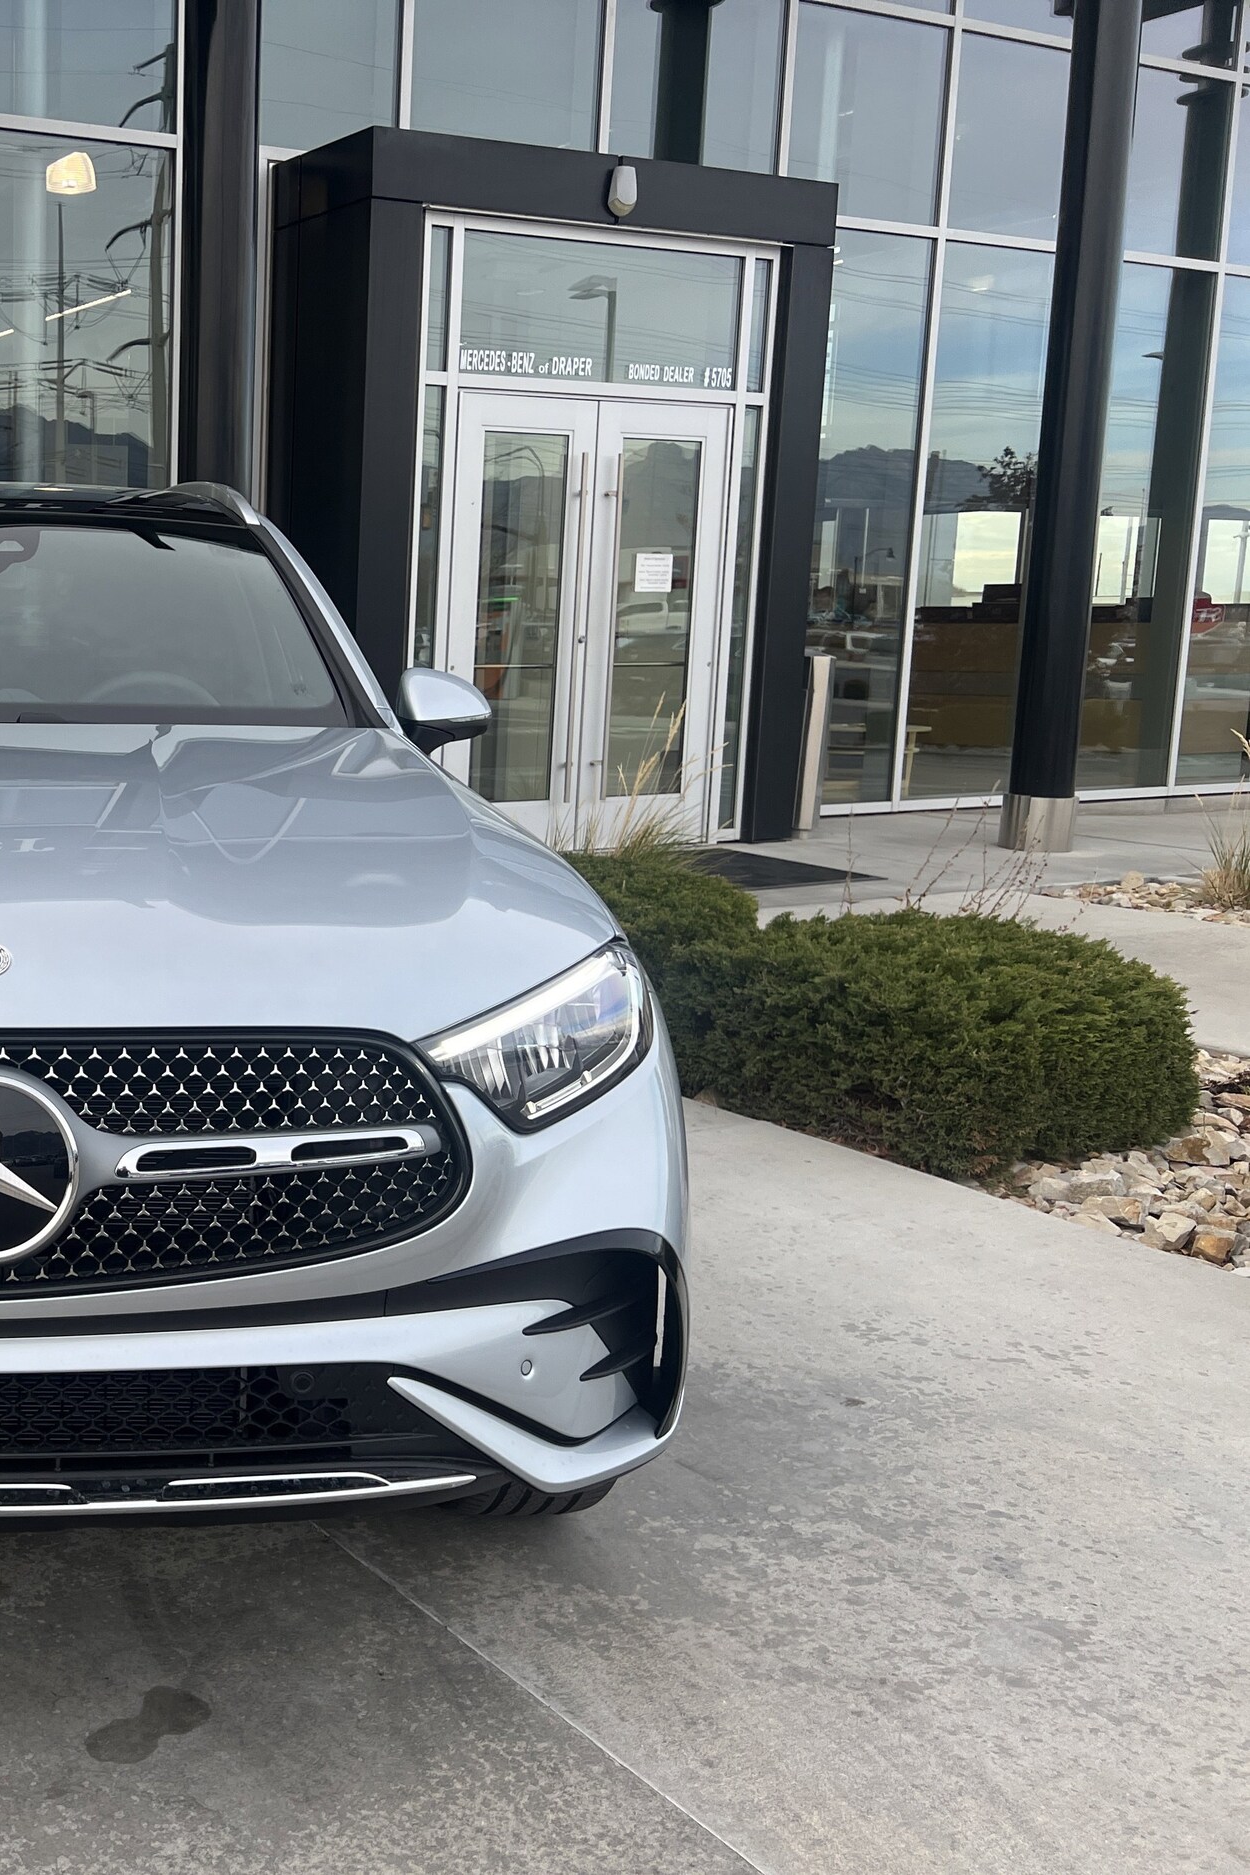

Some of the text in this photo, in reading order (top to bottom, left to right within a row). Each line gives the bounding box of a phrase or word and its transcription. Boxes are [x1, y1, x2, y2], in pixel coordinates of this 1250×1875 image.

[538, 363, 549, 374] of
[551, 356, 593, 376] DRAPER
[628, 363, 660, 381] BONDED
[663, 366, 695, 383] DEALER
